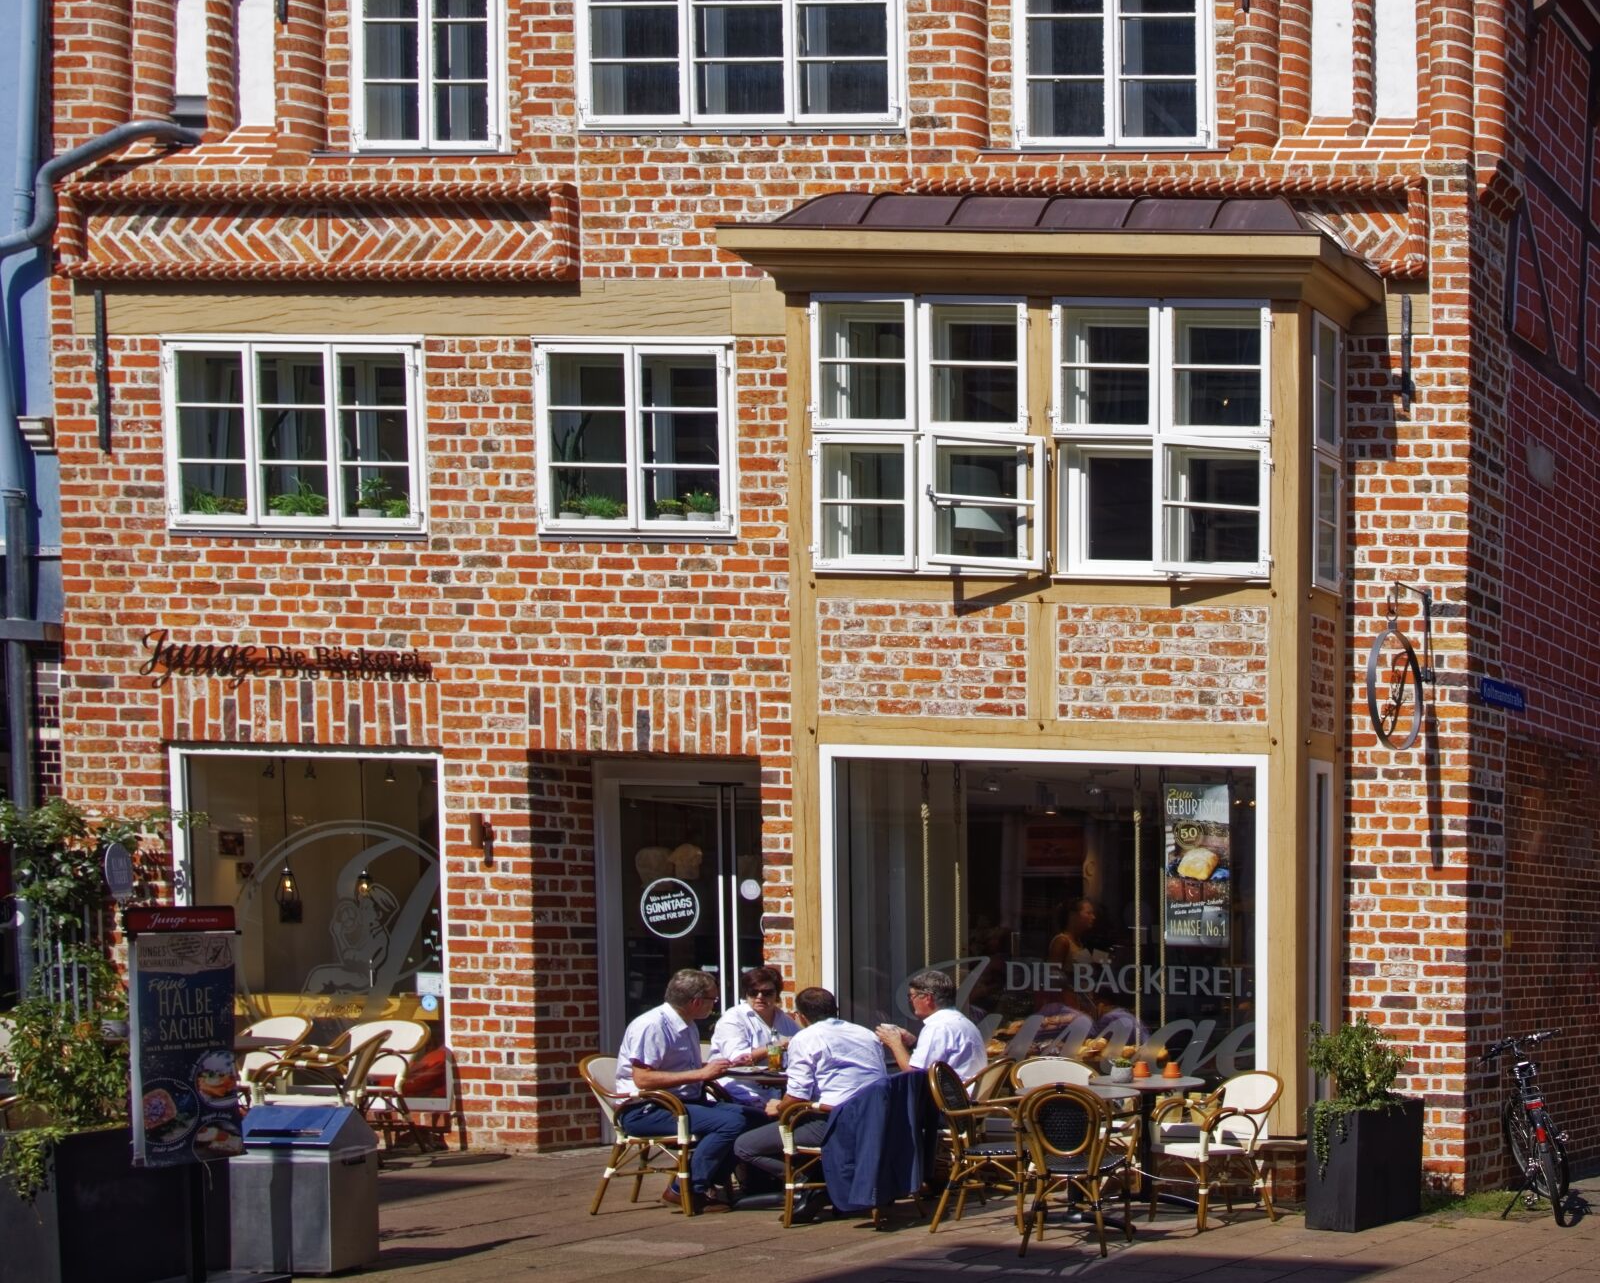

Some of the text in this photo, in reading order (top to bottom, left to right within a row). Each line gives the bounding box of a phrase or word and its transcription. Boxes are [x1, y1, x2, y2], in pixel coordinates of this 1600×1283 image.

[139, 629, 257, 677] Junge
[265, 646, 306, 667] Die
[1166, 798, 1228, 815] GEBURTSTA
[1180, 827, 1198, 839] 50
[645, 897, 693, 914] SONNTAGS
[147, 913, 187, 929] Junge
[1170, 920, 1226, 936] HANSE No.1
[148, 976, 187, 992] Feine
[1006, 961, 1062, 992] DIE
[159, 987, 214, 1016] HALBE
[159, 1015, 214, 1042] SACHEN
